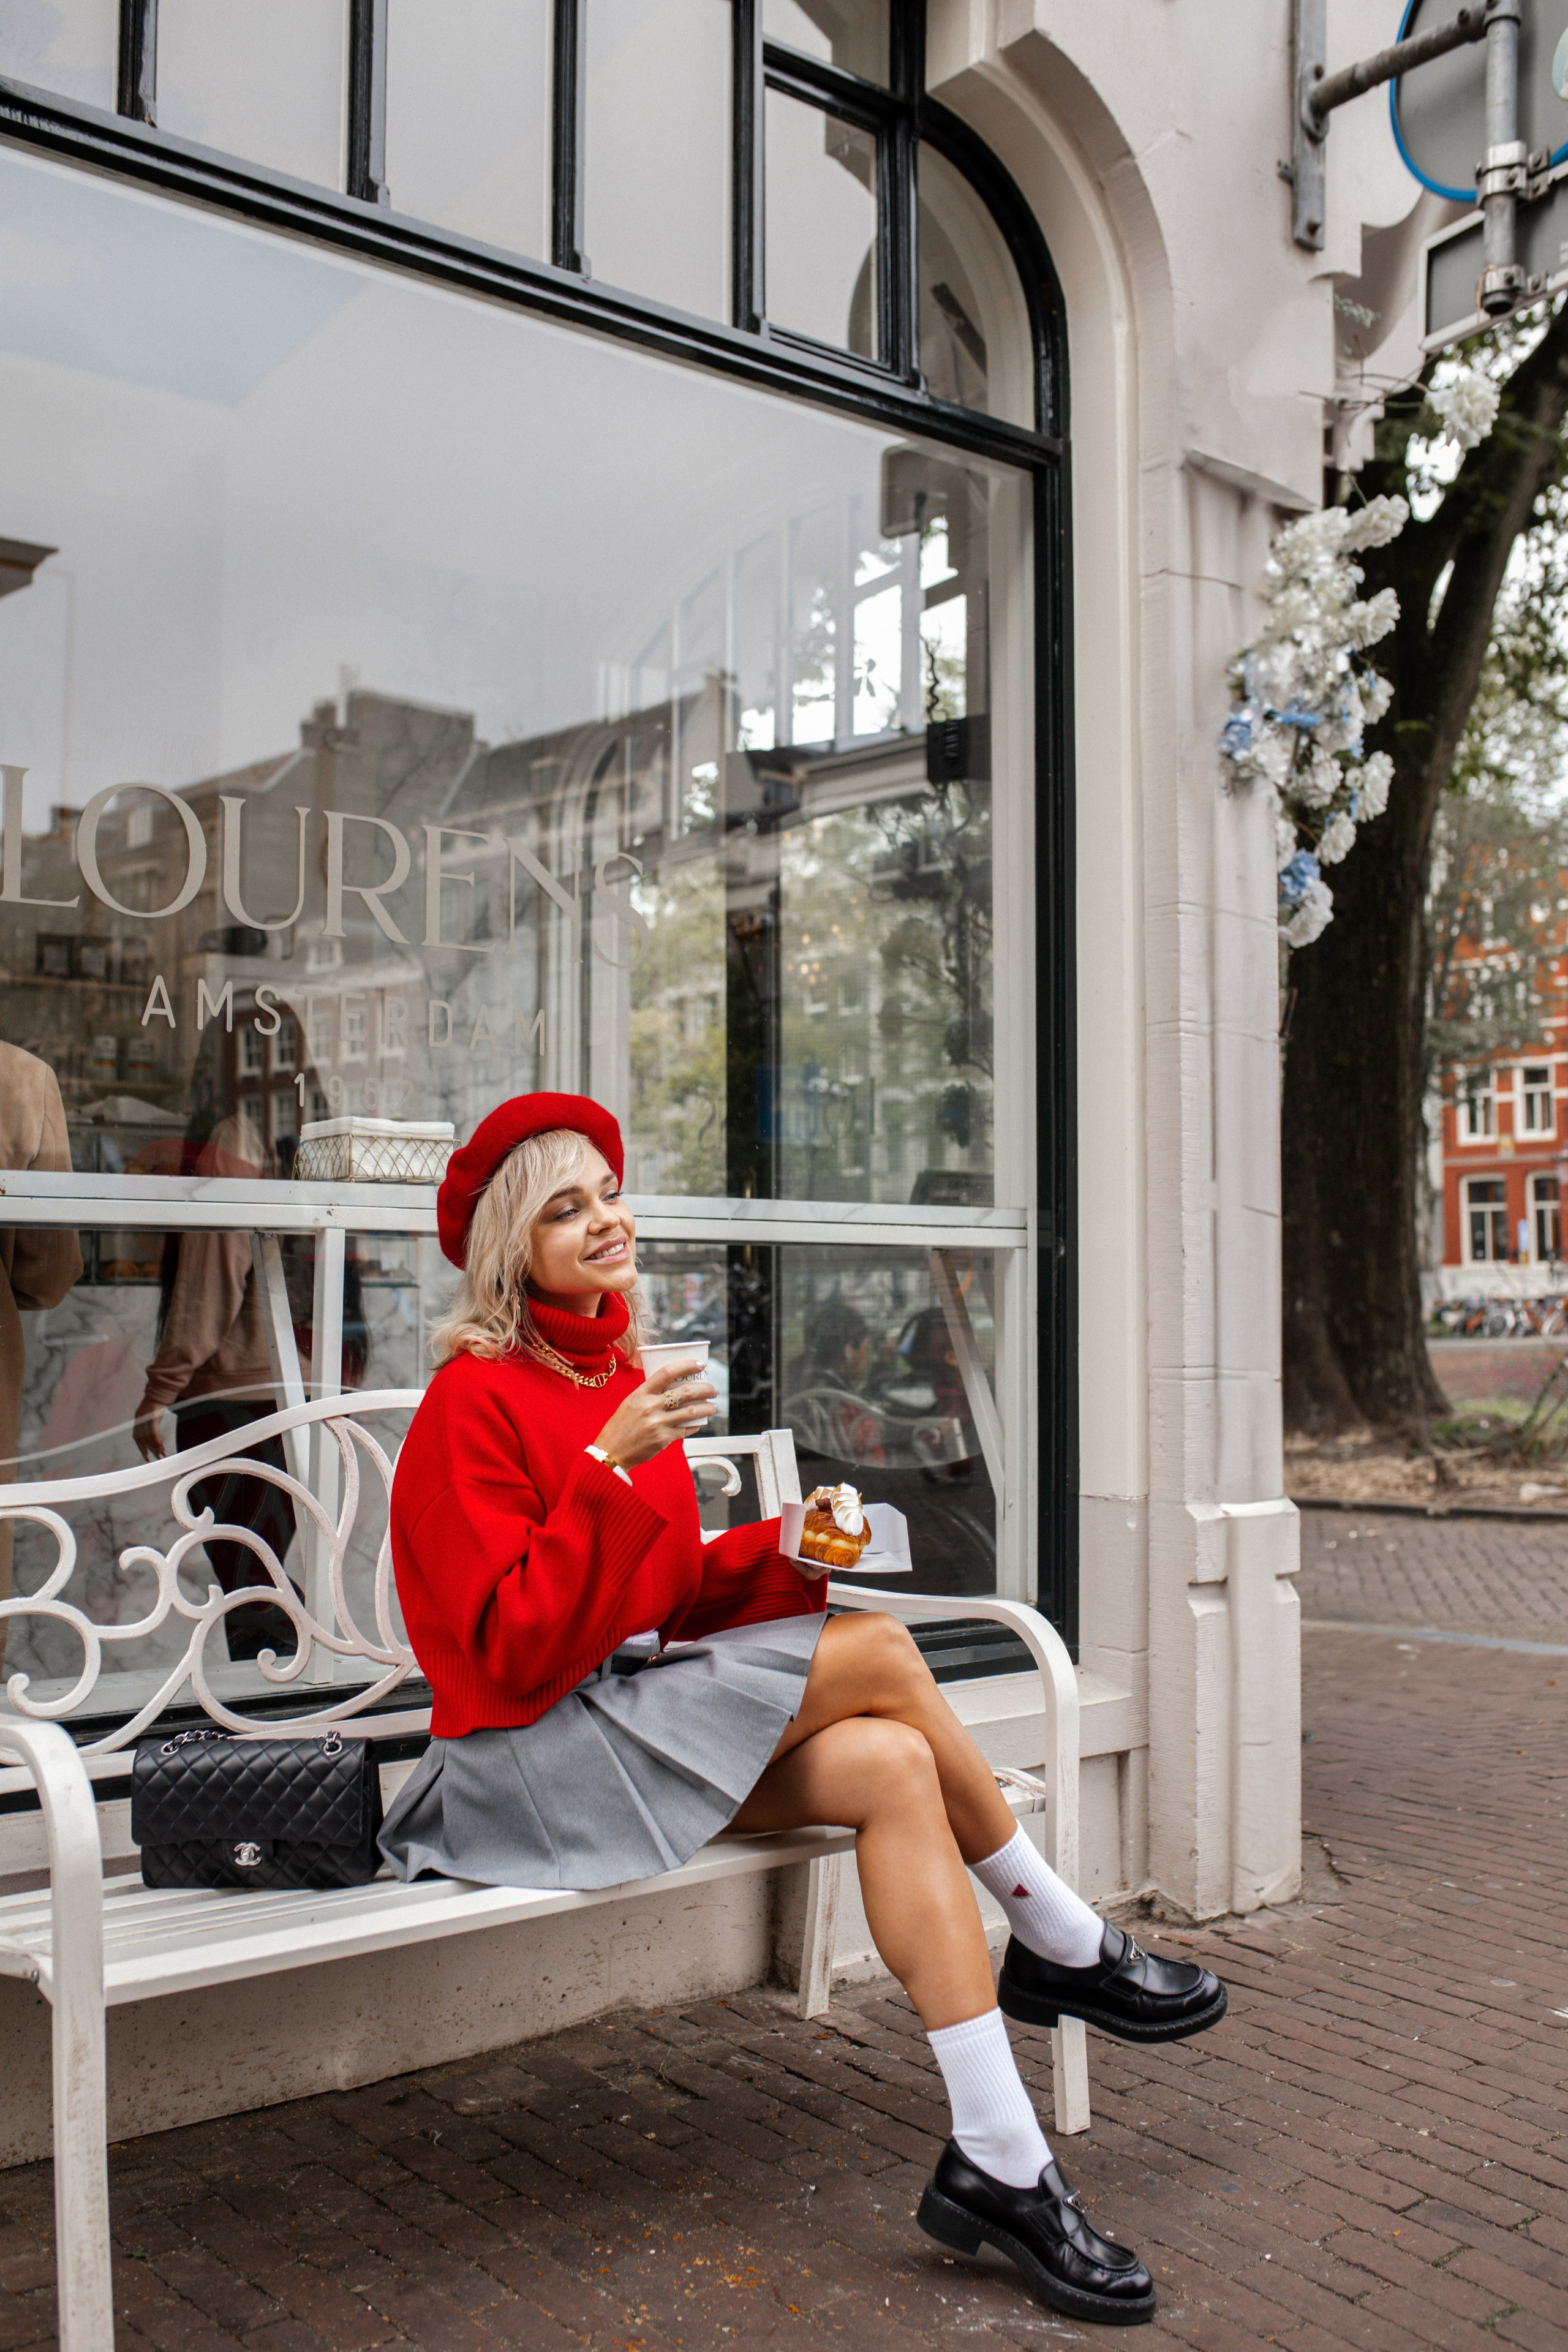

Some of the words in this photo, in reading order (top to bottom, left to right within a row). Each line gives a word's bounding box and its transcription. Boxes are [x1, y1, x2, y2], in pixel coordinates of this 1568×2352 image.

[0, 764, 650, 969] LOURENS
[141, 975, 545, 1056] AMSTERDAM
[294, 1073, 414, 1114] 1952
